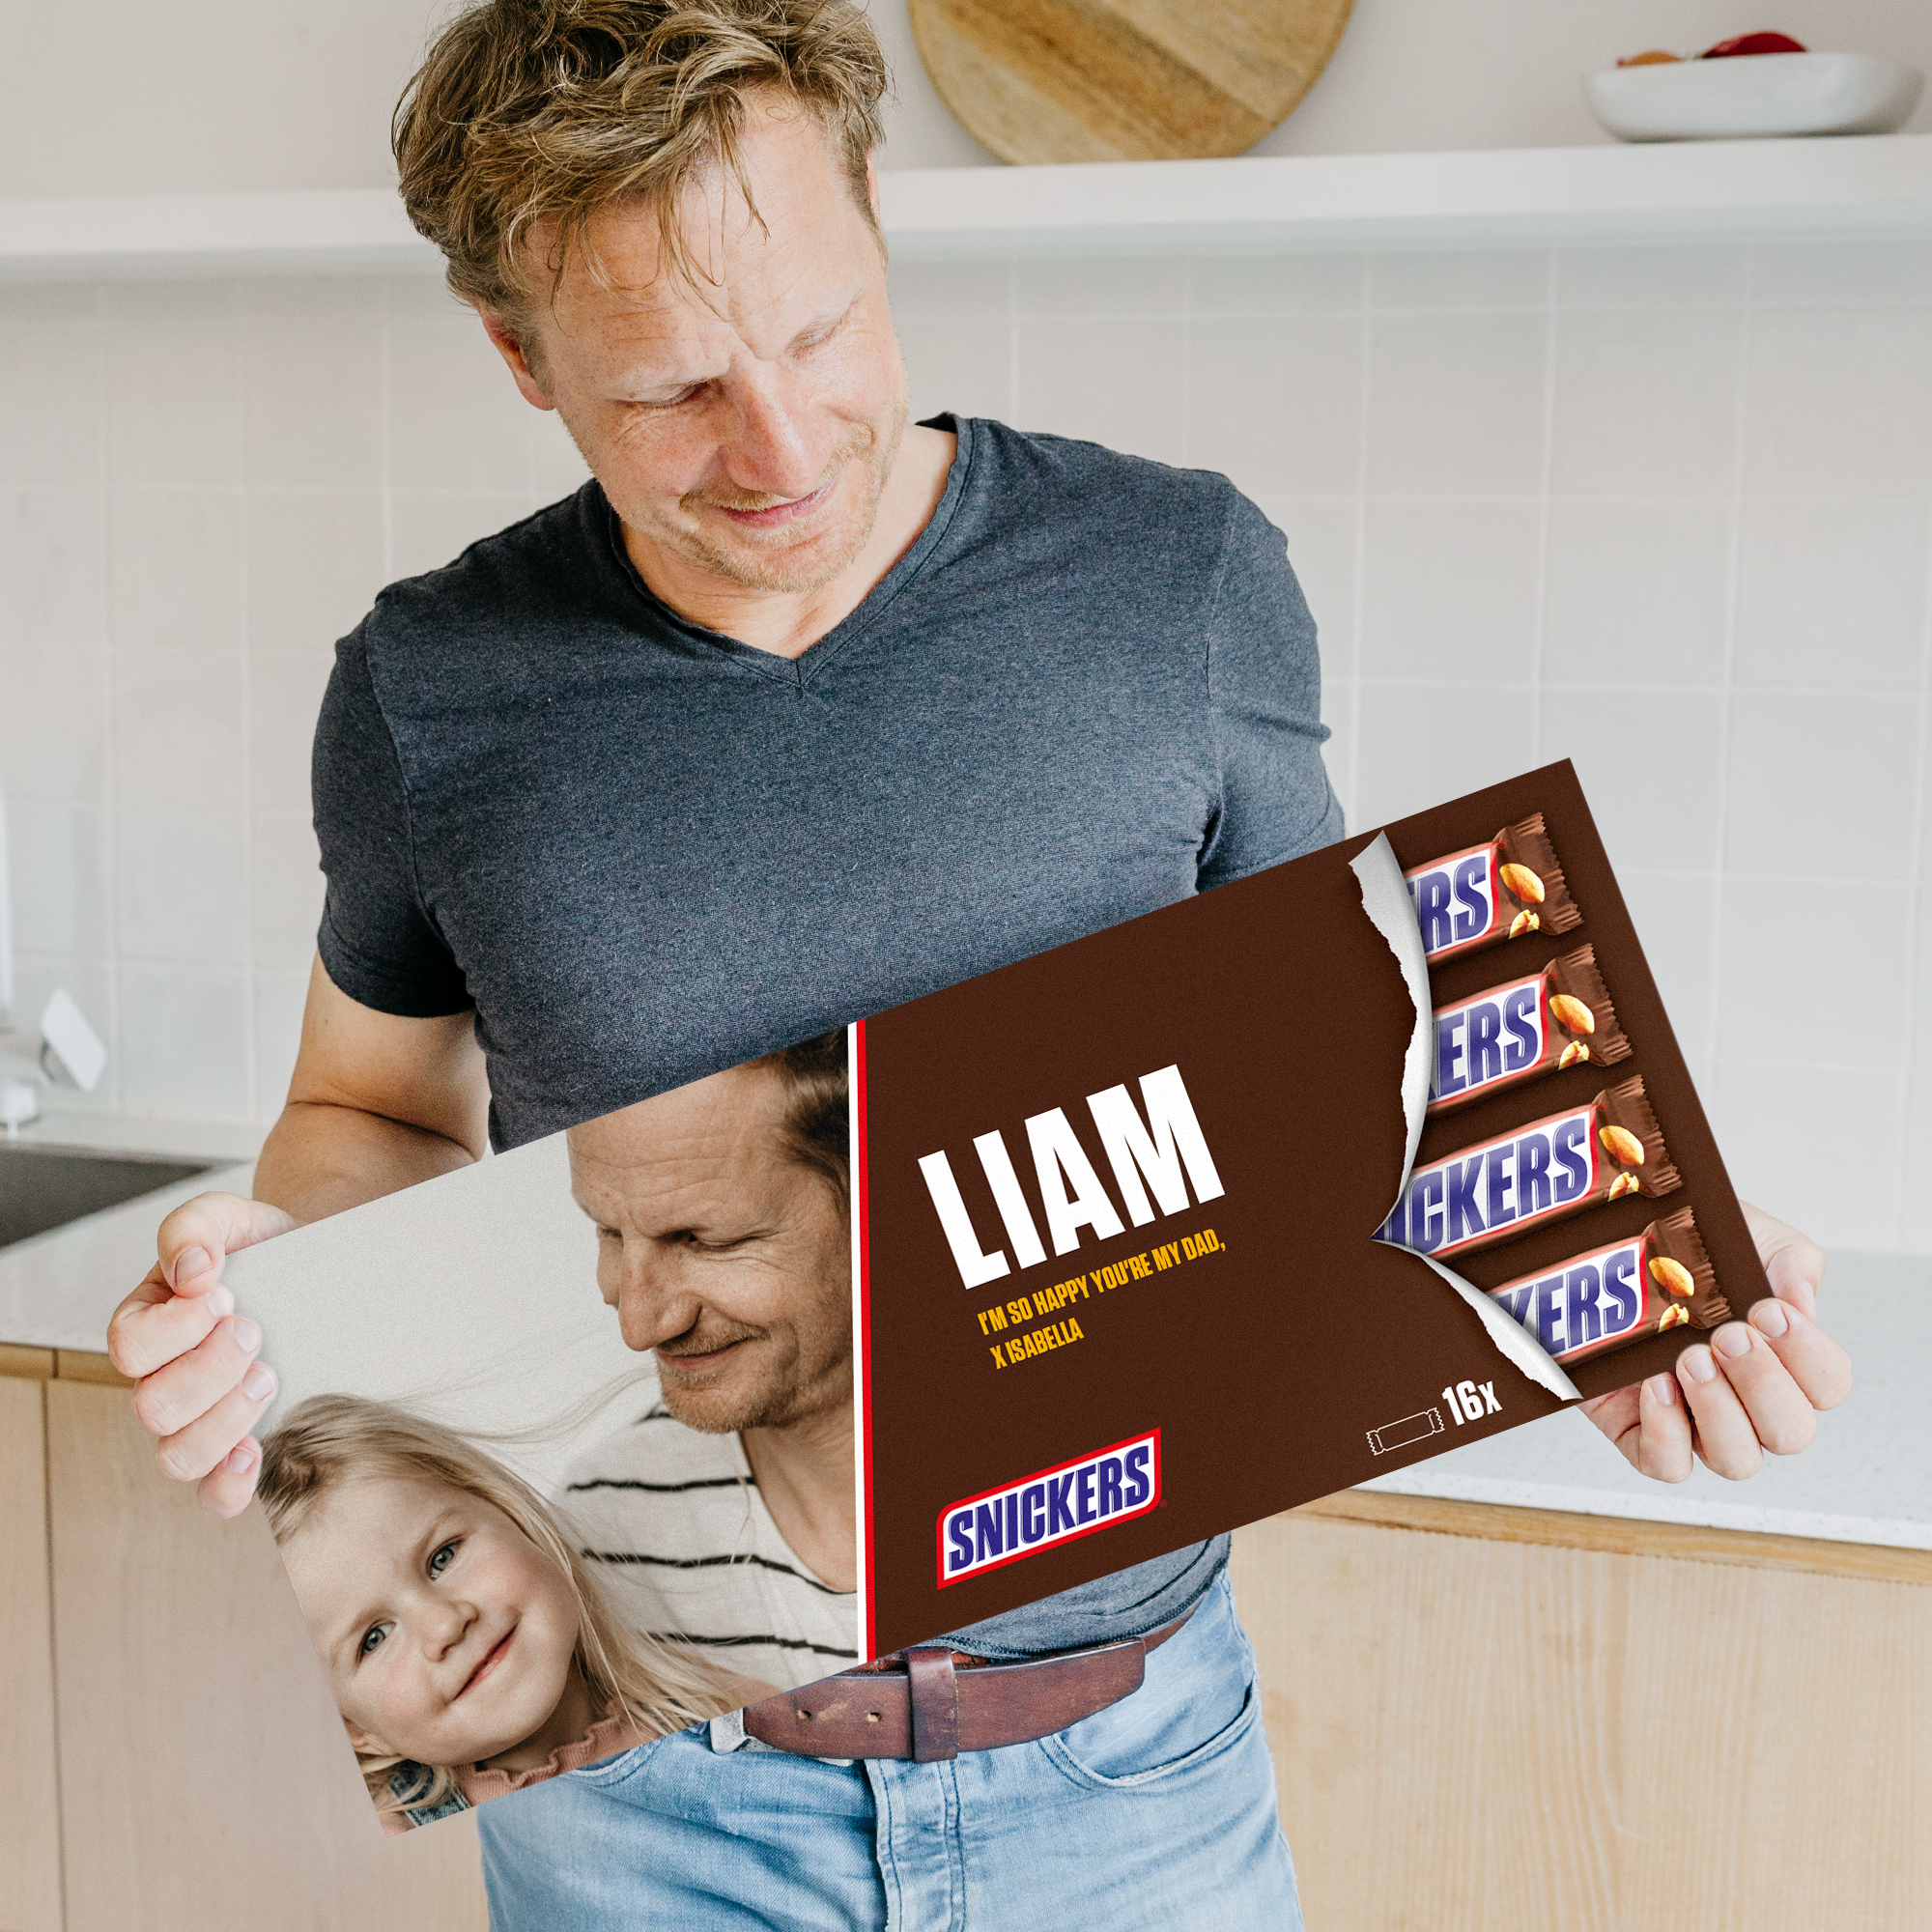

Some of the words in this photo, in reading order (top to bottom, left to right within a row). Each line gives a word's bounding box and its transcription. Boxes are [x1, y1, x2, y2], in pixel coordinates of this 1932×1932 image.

[1406, 856, 1489, 952] RS
[1427, 986, 1539, 1101] ERS
[918, 1064, 1226, 1290] LIAM
[977, 1306, 1009, 1336] I'M
[1007, 1297, 1034, 1324] SO
[1032, 1275, 1090, 1316] HAPPY
[1090, 1252, 1153, 1293] YOU'RE
[1151, 1241, 1181, 1271] MY
[1180, 1229, 1226, 1261] DAD,
[989, 1344, 1008, 1370] X
[1005, 1317, 1085, 1364] ISABELLA
[1442, 1380, 1502, 1426] 16x
[948, 1445, 1150, 1572] SNICKERS
